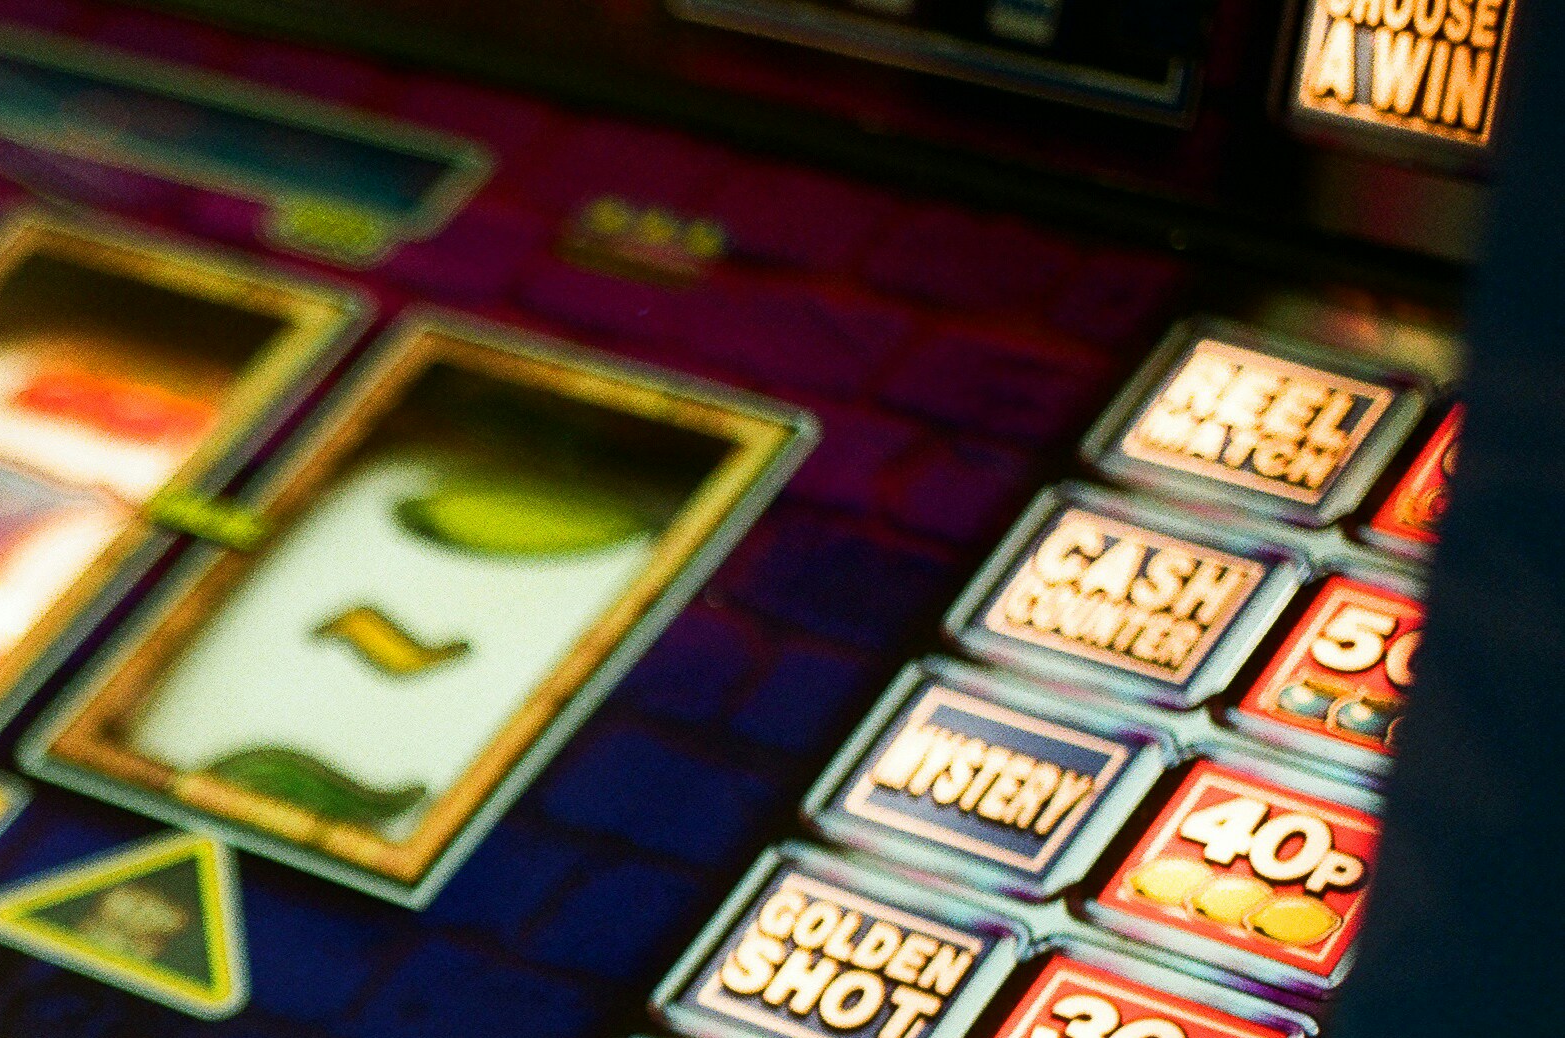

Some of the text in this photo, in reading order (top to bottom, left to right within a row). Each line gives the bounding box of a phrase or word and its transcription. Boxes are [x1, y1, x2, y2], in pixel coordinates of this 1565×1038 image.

[1311, 16, 1492, 130] A WIN
[1139, 405, 1341, 492] MATCH
[1177, 350, 1355, 450] REEL
[1035, 518, 1241, 625] CASH
[1005, 585, 1204, 672] COUNTER
[872, 722, 1095, 836] MYSTERY
[755, 888, 977, 998] GOLDEN
